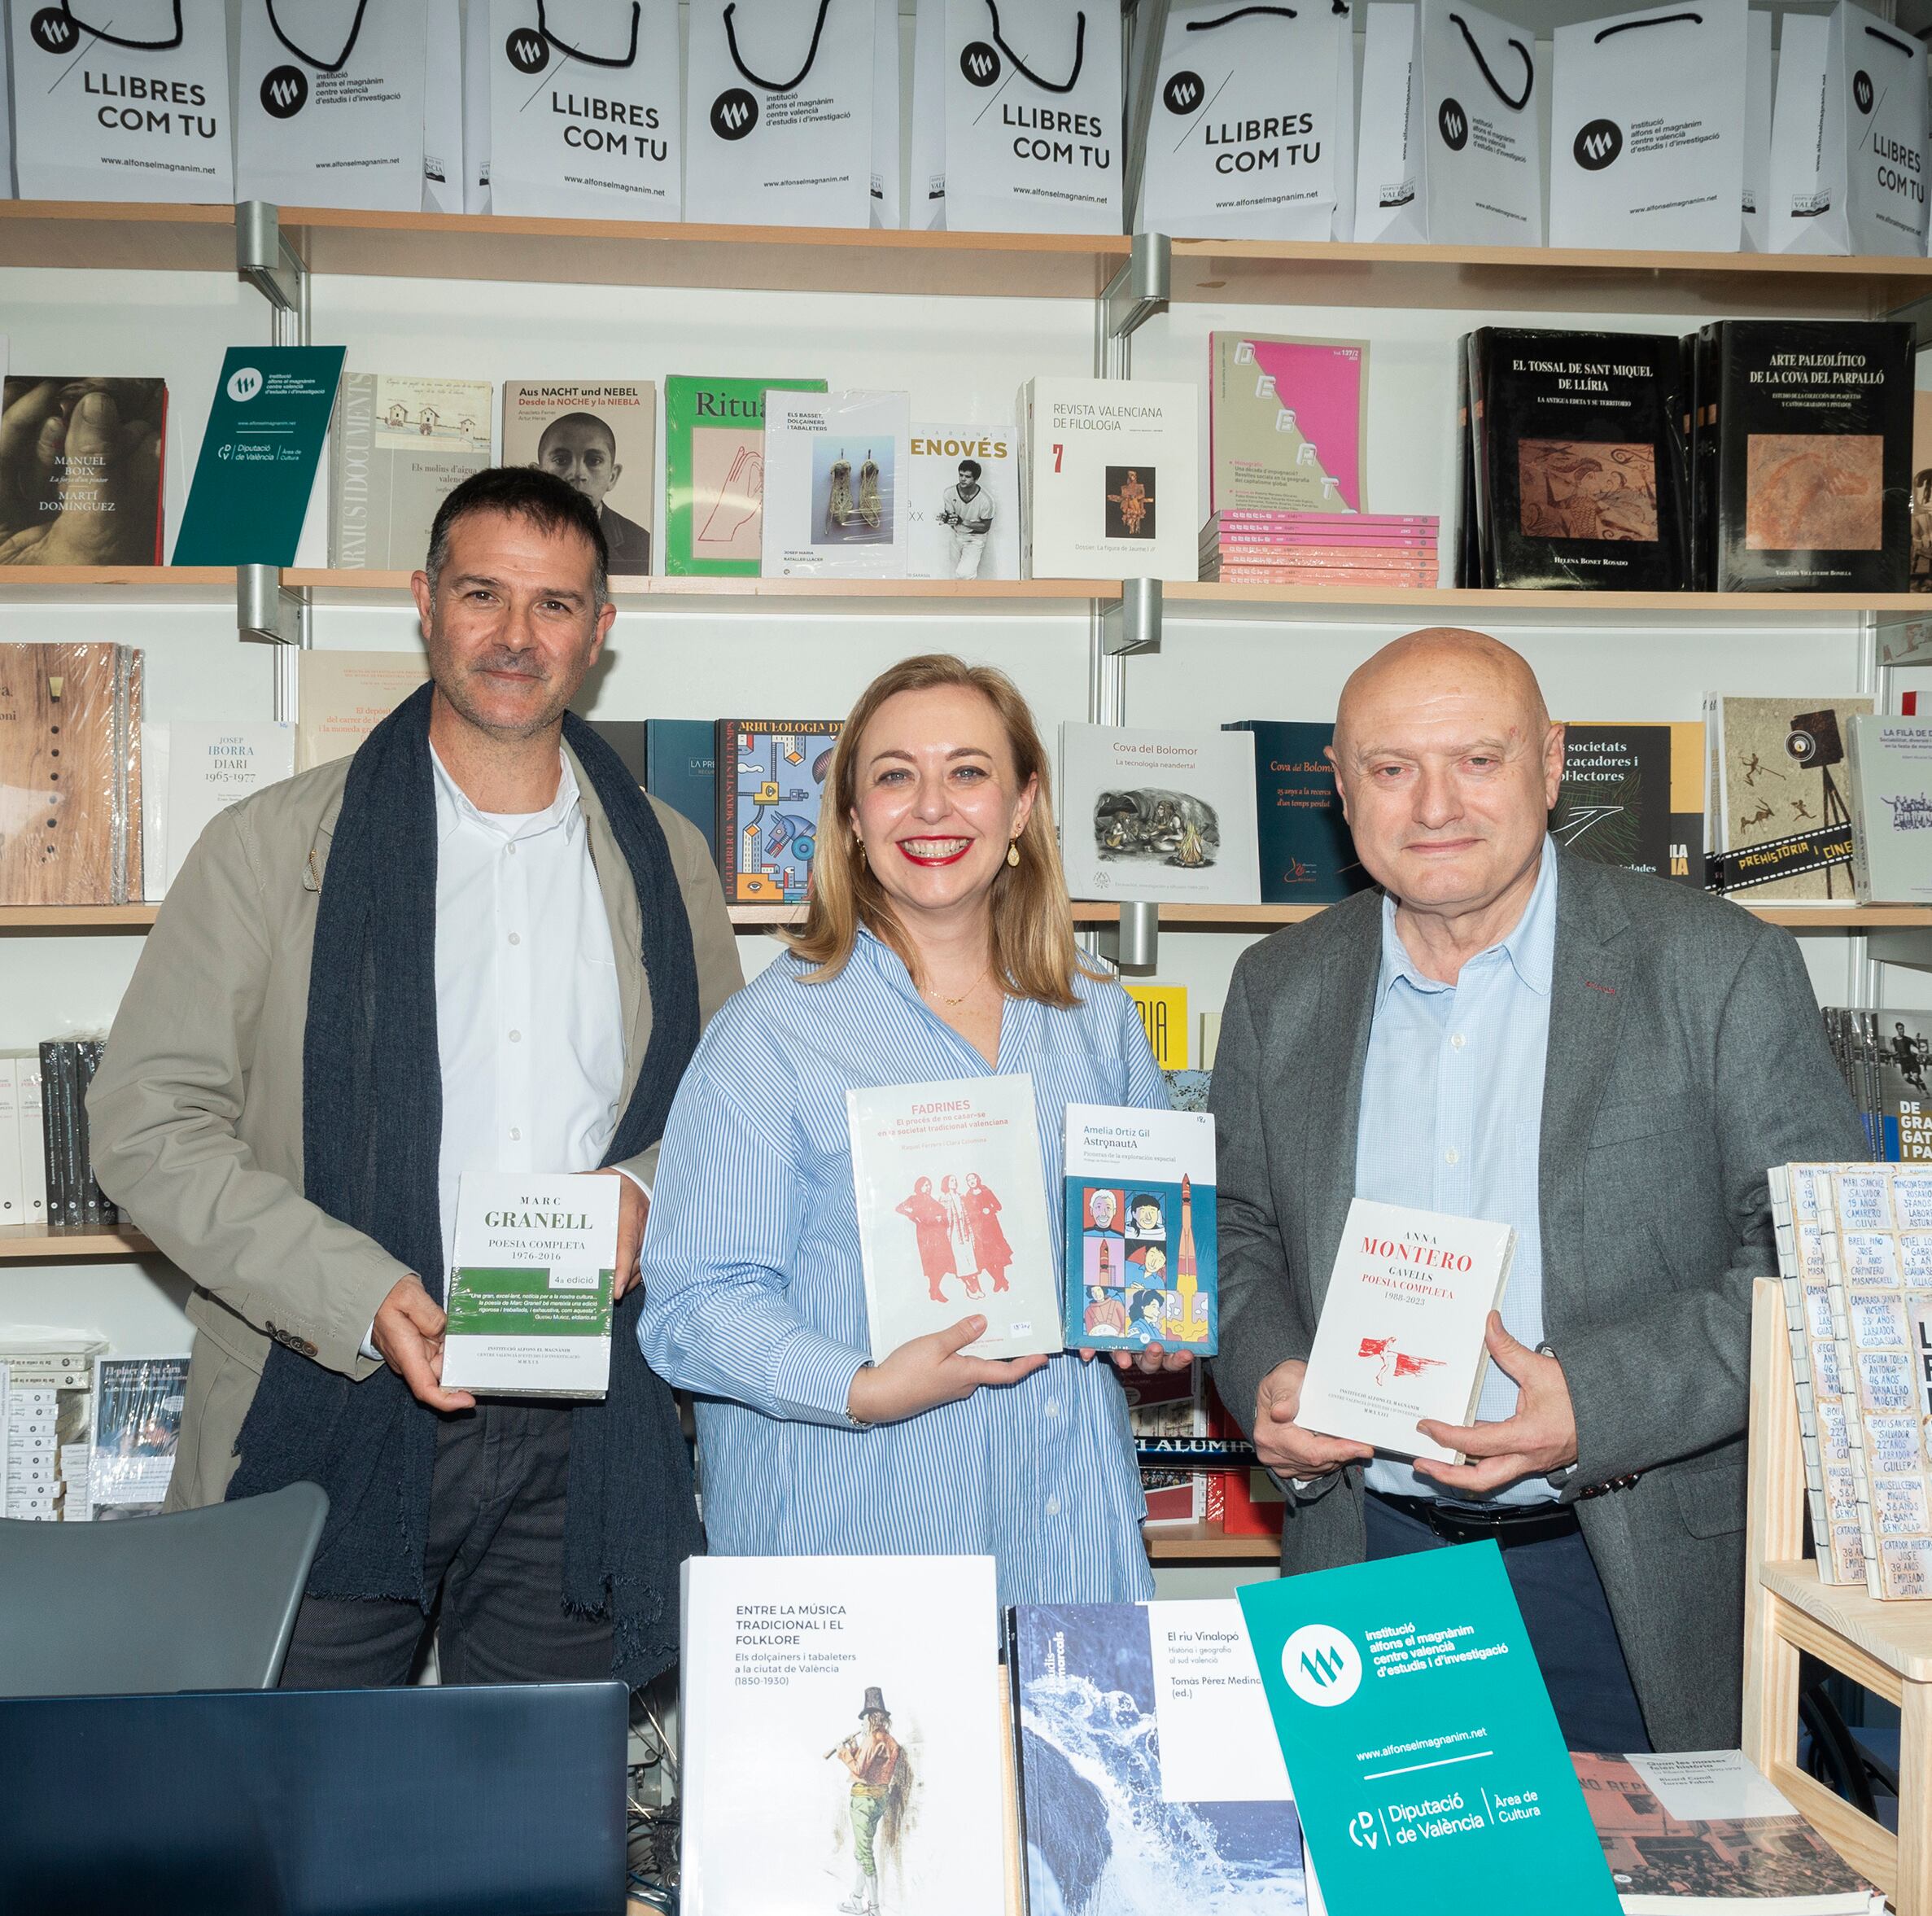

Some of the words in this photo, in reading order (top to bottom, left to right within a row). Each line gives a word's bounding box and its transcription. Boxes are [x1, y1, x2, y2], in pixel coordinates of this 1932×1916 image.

[84, 70, 207, 107] LLIBRES
[98, 106, 171, 134] COM
[179, 115, 216, 138] TU
[1205, 112, 1313, 145] LLIBRES
[1631, 118, 1663, 129] institució
[1631, 129, 1653, 138] alfons
[1663, 120, 1702, 133] magnànim
[1630, 143, 1663, 154] d'estudis
[1669, 133, 1720, 147] d'investigació
[1631, 137, 1654, 146] centre
[1656, 131, 1685, 142] valencià
[101, 155, 216, 175] www.alfonselmagnanim.net
[1215, 148, 1279, 174] COM
[1286, 142, 1322, 166] TU
[1216, 190, 1319, 208] www.alfonselmagnanim.net
[1629, 195, 1717, 213] www.alfonselmagnanim.net
[1770, 355, 1796, 365] ARTE
[1799, 352, 1866, 366] PALEOLÍTICO
[1513, 360, 1526, 370] EL
[1528, 361, 1566, 373] TOSSAL
[1568, 363, 1582, 374] DE
[1585, 364, 1610, 375] SANT
[1613, 365, 1653, 378] MIQUEL
[1750, 372, 1764, 383] DE
[1766, 372, 1779, 383] LA
[1781, 372, 1808, 383] COVA
[1811, 372, 1831, 383] DEL
[1833, 370, 1884, 384] PARPALLÓ
[581, 387, 601, 396] und
[1558, 378, 1572, 390] DE
[1575, 378, 1608, 392] LLÍRIA
[695, 392, 766, 418] Ritu
[1054, 404, 1095, 415] REVISTA
[1099, 406, 1163, 418] VALENCIANA
[1054, 418, 1067, 428] DE
[1070, 419, 1121, 431] FILOLOGIA
[344, 372, 373, 493] DOCUMENTS
[911, 437, 1008, 458] ENOVÉS
[55, 456, 106, 466] MANUEL
[1053, 444, 1063, 473] 7
[65, 467, 94, 475] BOIX
[59, 490, 98, 500] MARTÍ
[39, 501, 116, 511] DOMÍNGUEZ
[1896, 728, 1913, 736] FILÀ
[208, 745, 254, 756] IBORRA
[1113, 742, 1136, 753] Cova
[1139, 744, 1154, 754] del
[1156, 745, 1198, 755] Bolomor
[1568, 741, 1627, 751] societats
[213, 759, 248, 769] DIARI
[1125, 759, 1158, 769] tecnologia
[1160, 761, 1195, 770] neandertal
[1567, 756, 1631, 768] caçadores
[1634, 756, 1637, 767] i
[205, 772, 256, 783] 1965-1977
[1738, 840, 1809, 870] PREHISTÒRIA
[1814, 846, 1818, 856] I
[1824, 842, 1853, 860] CINE
[911, 1100, 970, 1115] FADRINES
[1900, 1101, 1920, 1114] DE
[898, 1126, 925, 1135] societat
[928, 1122, 967, 1131] tradicional
[969, 1118, 1008, 1127] valenciana
[1084, 1126, 1112, 1135] Amelia
[1116, 1127, 1136, 1137] Ortiz
[1139, 1129, 1150, 1137] Gil
[1849, 1189, 1881, 1197] SALVADOR
[520, 1196, 561, 1205] MARC
[485, 1211, 592, 1230] GRANELL
[1846, 1209, 1881, 1218] CAMARERO
[488, 1240, 526, 1249] POESIA
[529, 1240, 585, 1249] COMPLETA
[1403, 1231, 1437, 1245] ANNA
[512, 1252, 561, 1260] 1976-2016
[1360, 1237, 1472, 1272] MONTERO
[566, 1275, 593, 1284] edició
[1388, 1266, 1433, 1281] GAVELLS
[1362, 1273, 1398, 1289] POESIA
[1400, 1281, 1453, 1299] COMPLETA
[1384, 1292, 1426, 1306] 1988-2023
[737, 1606, 776, 1615] ENTRE
[780, 1606, 795, 1614] LA
[799, 1603, 846, 1614] MÚSICA
[737, 1621, 820, 1629] TRADICIONAL
[824, 1621, 825, 1629] I
[830, 1621, 844, 1629] EL
[1365, 1622, 1415, 1641] institució
[737, 1636, 800, 1645] FOLKLORE
[1168, 1632, 1175, 1641] El
[1179, 1631, 1192, 1641] riu
[1195, 1631, 1239, 1643] Vinalopó
[1370, 1639, 1403, 1653] alfons
[1405, 1635, 1415, 1646] el
[1417, 1625, 1475, 1644] magnànim
[736, 1653, 749, 1661] Els
[751, 1652, 800, 1663] dolçainers
[809, 1653, 856, 1661] tabaleters
[1373, 1651, 1409, 1665] centre
[1410, 1641, 1455, 1658] valencià
[1377, 1660, 1427, 1678] d'estudis
[1427, 1657, 1432, 1668] i
[1435, 1643, 1509, 1667] d'investigació
[735, 1677, 789, 1686] (1850-1930)
[1171, 1677, 1199, 1685] Tomàs
[1202, 1677, 1226, 1685] Pérez
[1173, 1689, 1192, 1699] (ed.)
[1357, 1727, 1488, 1761] www.alfonselmagnanim.net
[1494, 1793, 1521, 1808] Àrea
[1523, 1791, 1538, 1802] de
[1388, 1792, 1464, 1822] Diputació
[1498, 1806, 1541, 1823] Cultura
[1396, 1827, 1417, 1844] de
[1417, 1813, 1485, 1839] València
